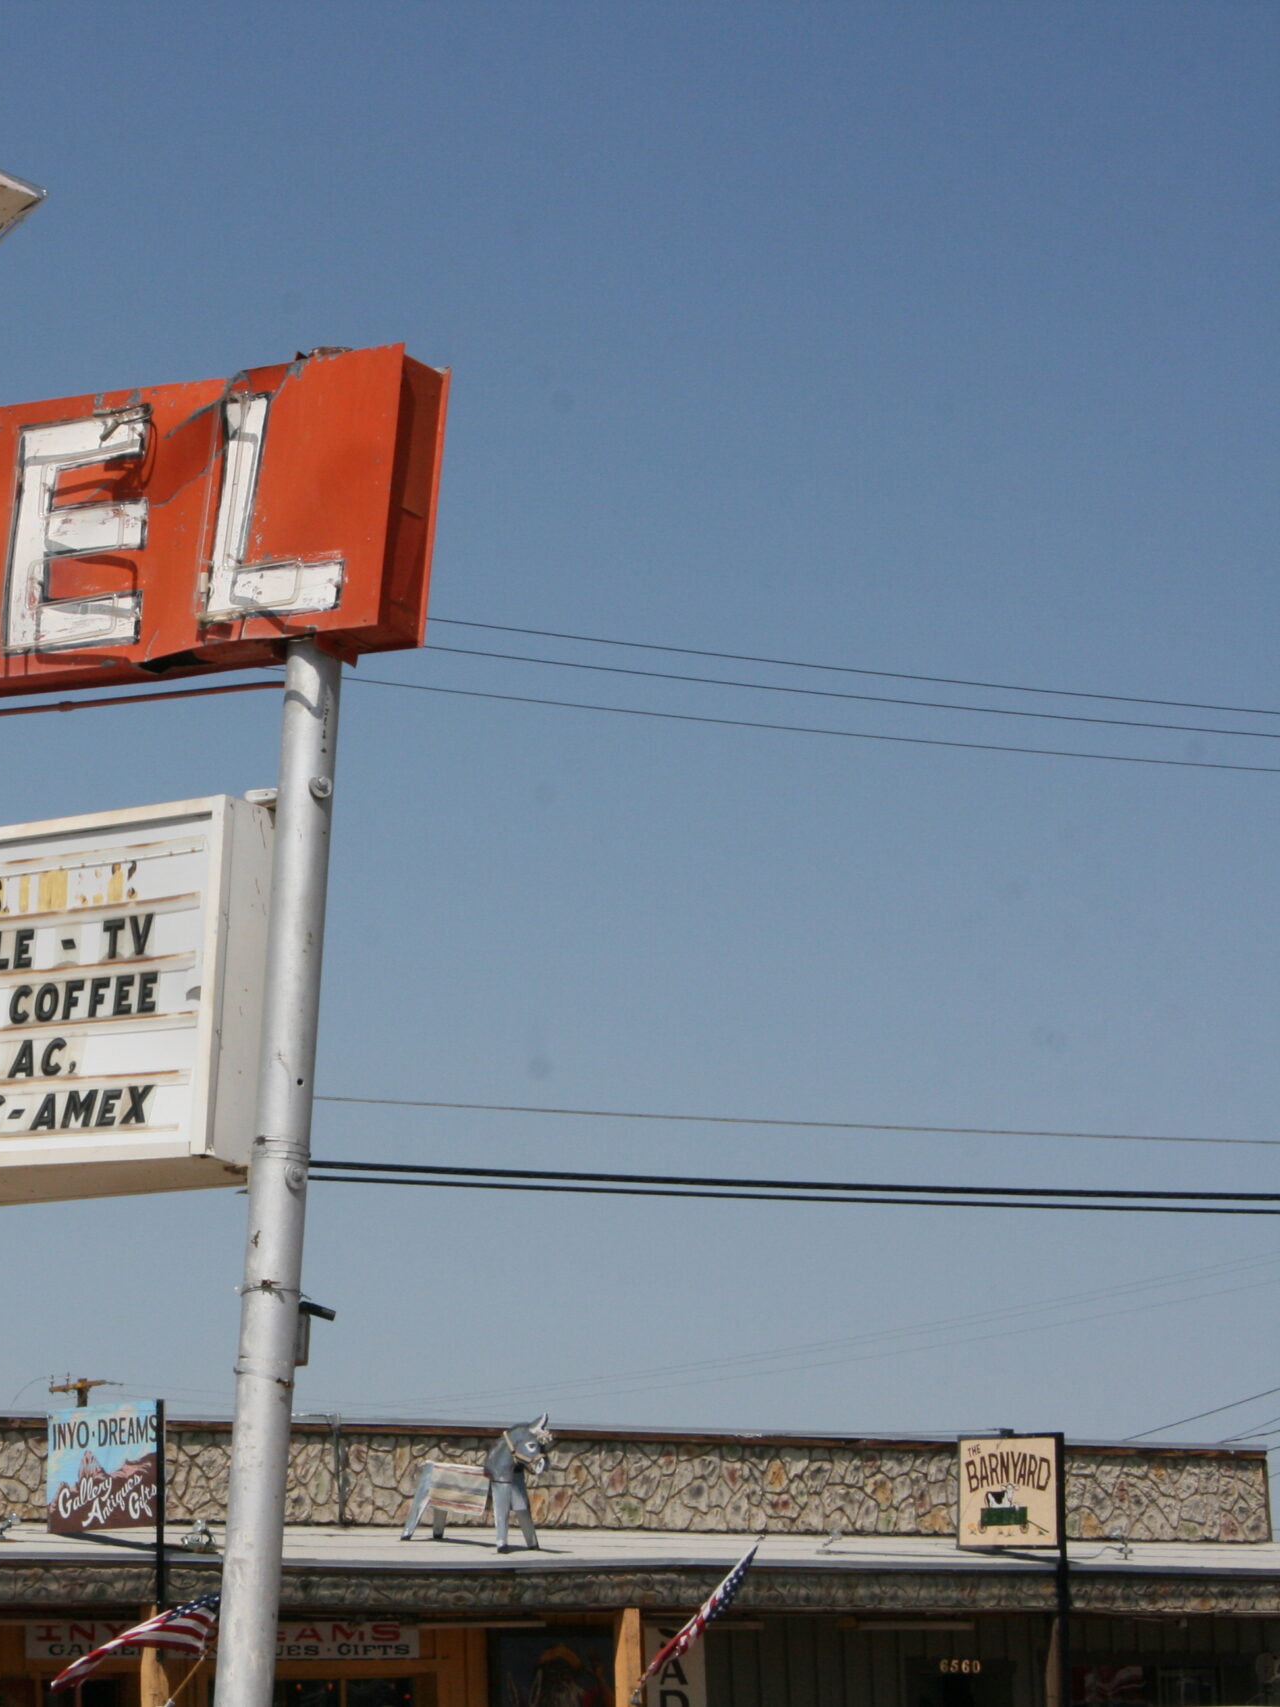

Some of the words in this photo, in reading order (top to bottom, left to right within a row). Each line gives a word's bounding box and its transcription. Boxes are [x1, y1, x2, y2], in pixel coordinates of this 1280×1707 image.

[102, 912, 154, 960] TV
[9, 971, 158, 1026] COFFEE
[53, 1420, 90, 1451] INYO
[98, 1414, 158, 1447] DREAMS
[967, 1444, 981, 1457] THE
[965, 1450, 1051, 1493] BARNYARD
[58, 1477, 113, 1519] Gallery
[81, 1474, 144, 1528] Antiques
[128, 1483, 157, 1519] Gifts
[36, 1623, 130, 1642] INY
[337, 1643, 410, 1656] GIFTS
[940, 1659, 981, 1673] 6560
